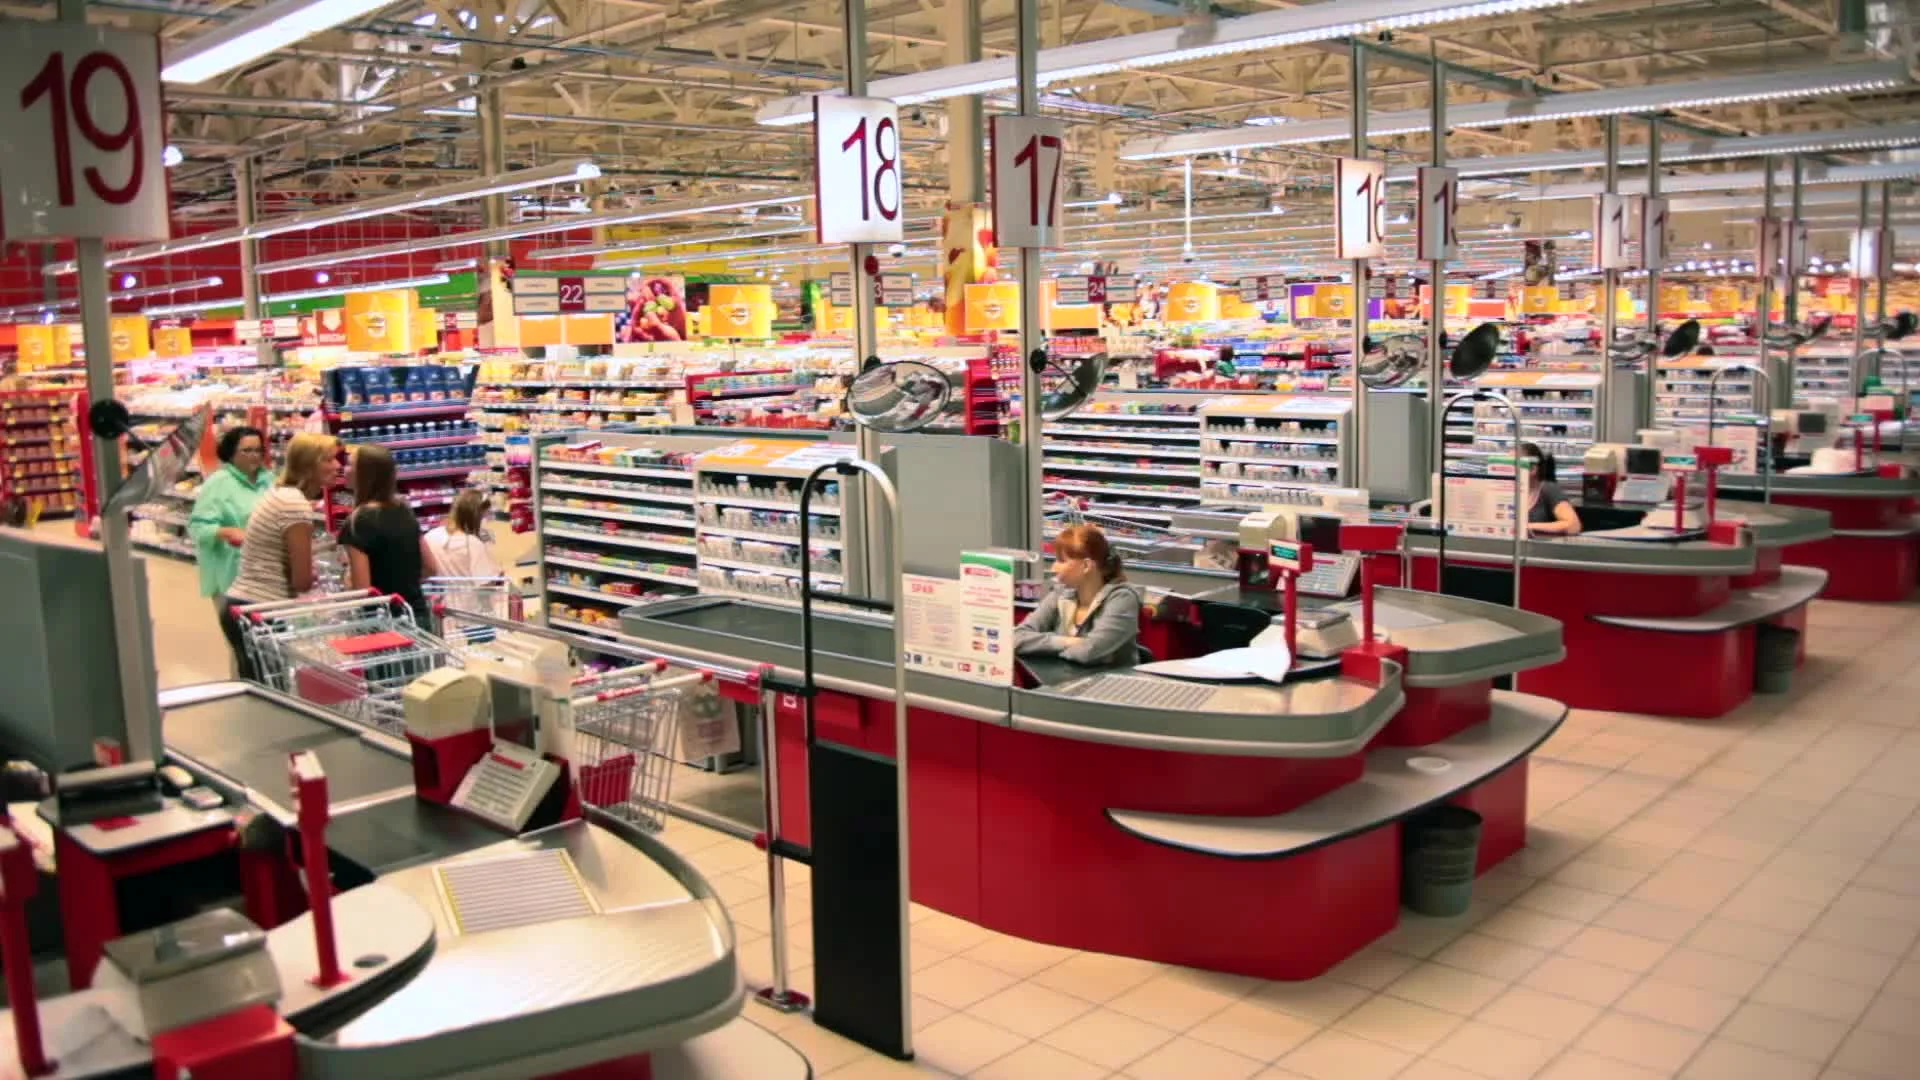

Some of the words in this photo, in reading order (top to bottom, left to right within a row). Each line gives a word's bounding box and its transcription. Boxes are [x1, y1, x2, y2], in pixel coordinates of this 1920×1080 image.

[20, 50, 145, 207] 19
[841, 116, 898, 221] 18
[1014, 133, 1062, 227] 17
[560, 284, 583, 304] 22
[873, 281, 882, 298] 3
[1088, 281, 1105, 297] 24
